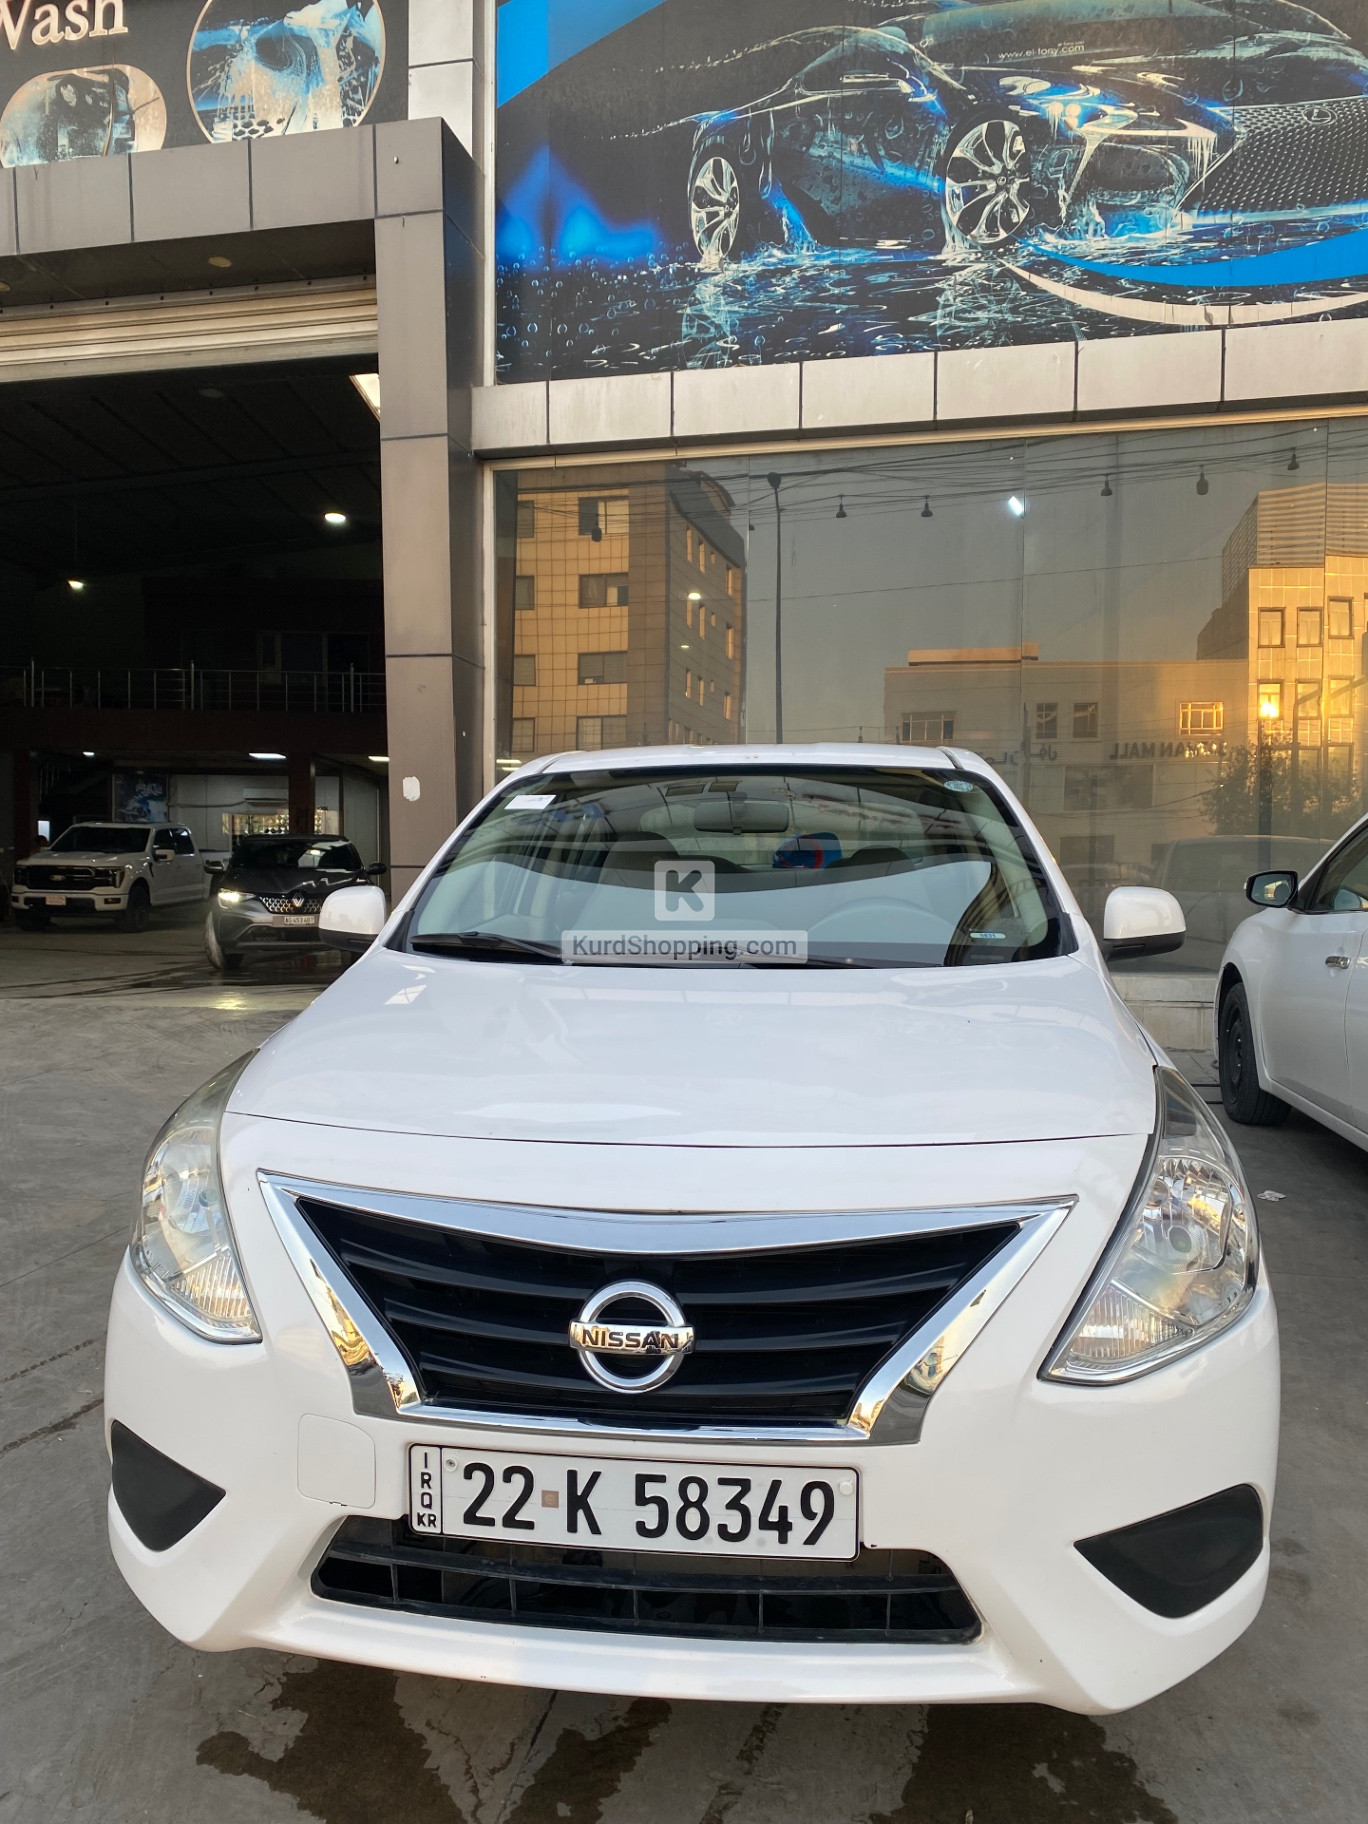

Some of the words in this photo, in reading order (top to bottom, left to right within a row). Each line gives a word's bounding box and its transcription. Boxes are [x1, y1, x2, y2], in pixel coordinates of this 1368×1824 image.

[582, 1329, 679, 1349] NISSAN
[463, 1462, 535, 1530] 22
[566, 1469, 602, 1535] K
[635, 1473, 835, 1546] 58349
